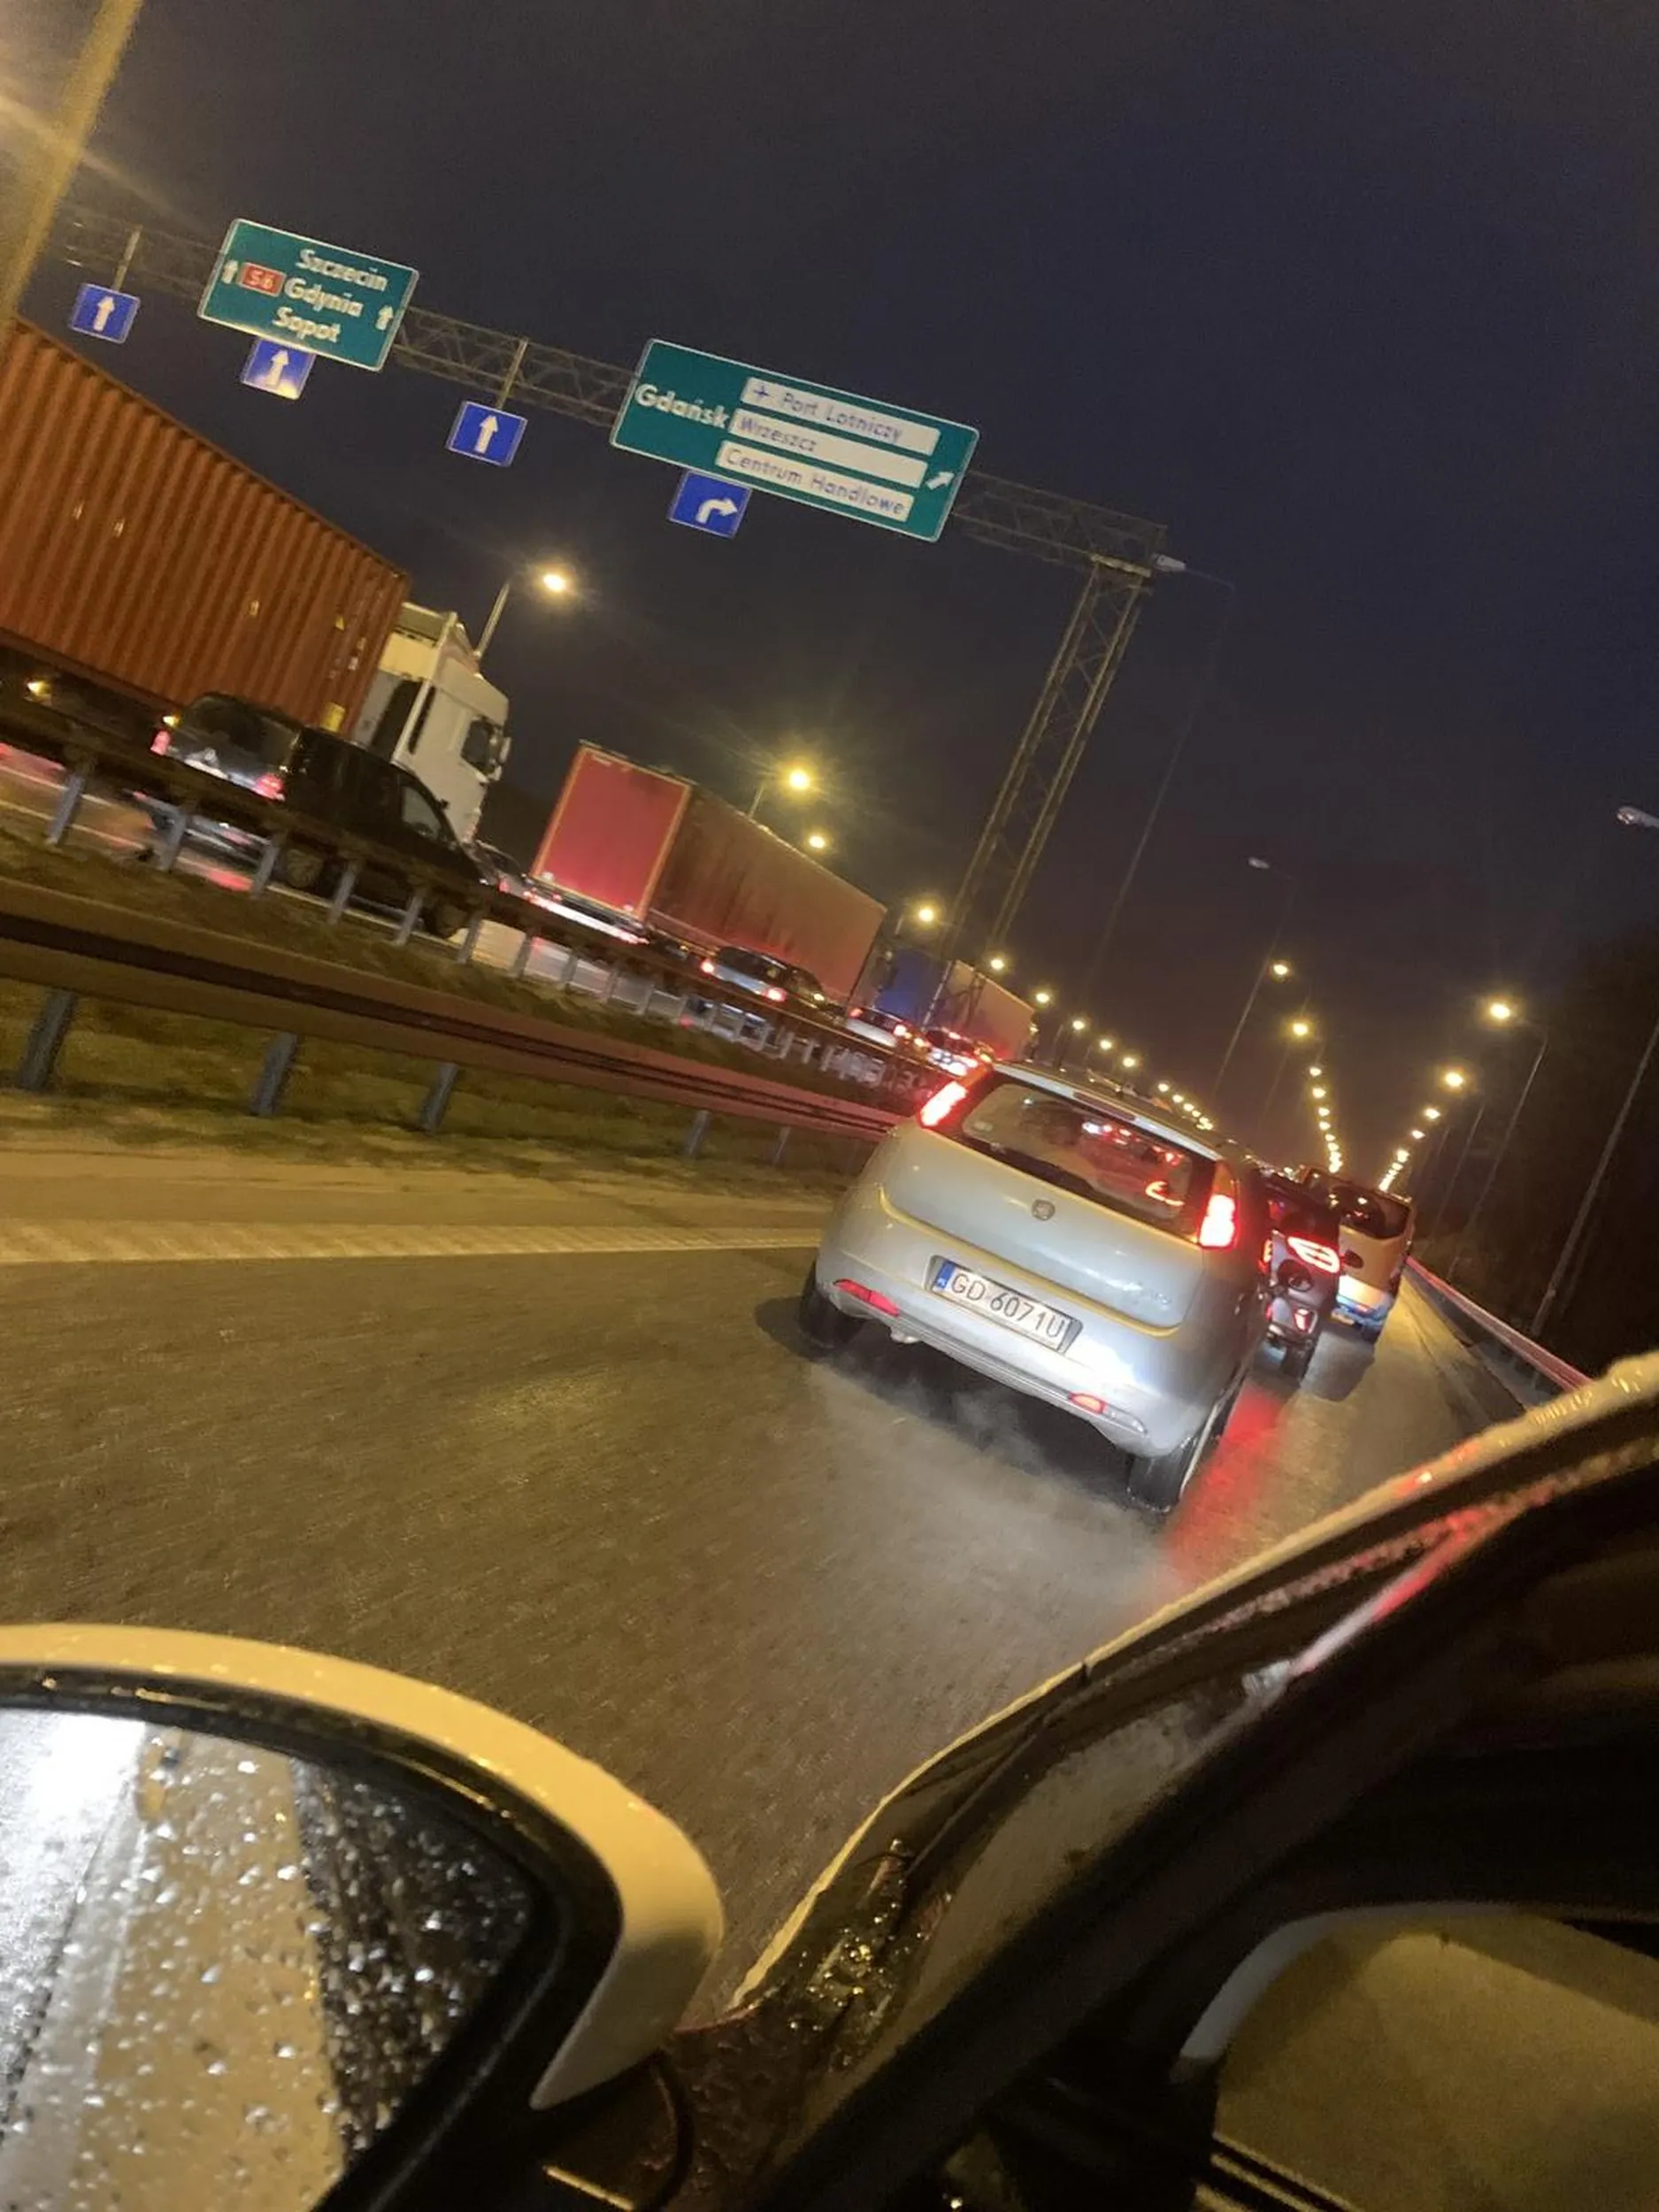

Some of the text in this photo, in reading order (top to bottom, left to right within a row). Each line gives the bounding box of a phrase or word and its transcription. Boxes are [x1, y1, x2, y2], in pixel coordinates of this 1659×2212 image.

[248, 267, 274, 290] S6
[296, 249, 388, 292] Szczecin
[284, 277, 364, 318] Gdynia
[272, 306, 342, 343] Sopot
[634, 382, 729, 430] Gdańsk
[782, 391, 903, 443] Port Lotniczy
[739, 417, 817, 453] Wrzeszcz
[726, 449, 906, 516] Centrum Handlowe
[951, 1273, 1065, 1339] GD 6071U
